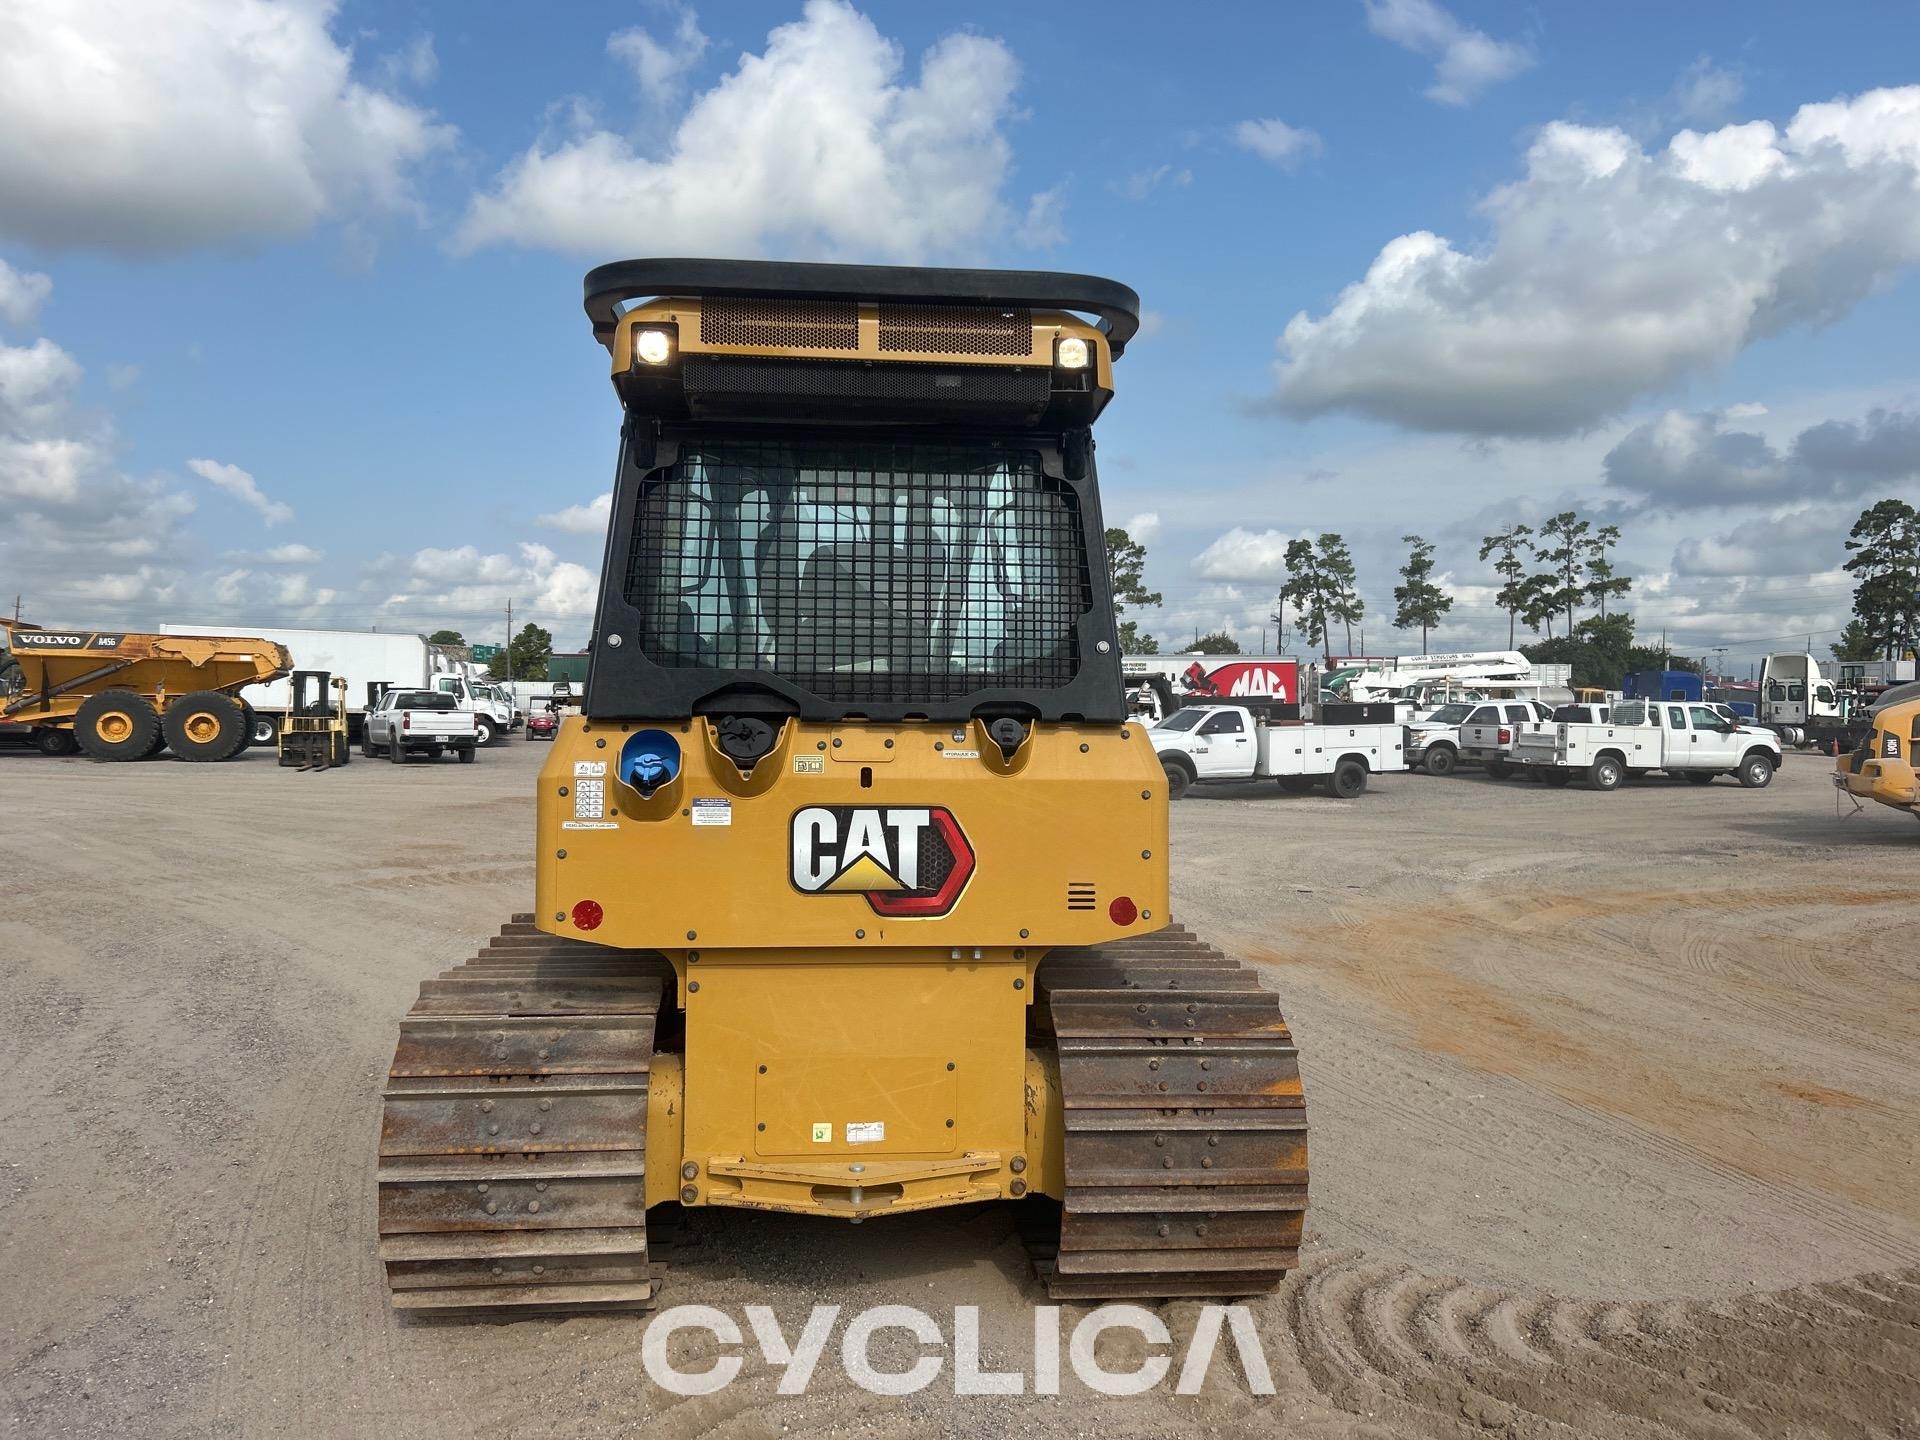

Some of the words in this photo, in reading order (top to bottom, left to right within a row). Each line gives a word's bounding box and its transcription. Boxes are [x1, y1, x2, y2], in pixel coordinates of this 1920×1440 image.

[18, 634, 81, 645] VOLVO
[1887, 738, 1898, 755] L90H
[793, 807, 930, 891] CAT
